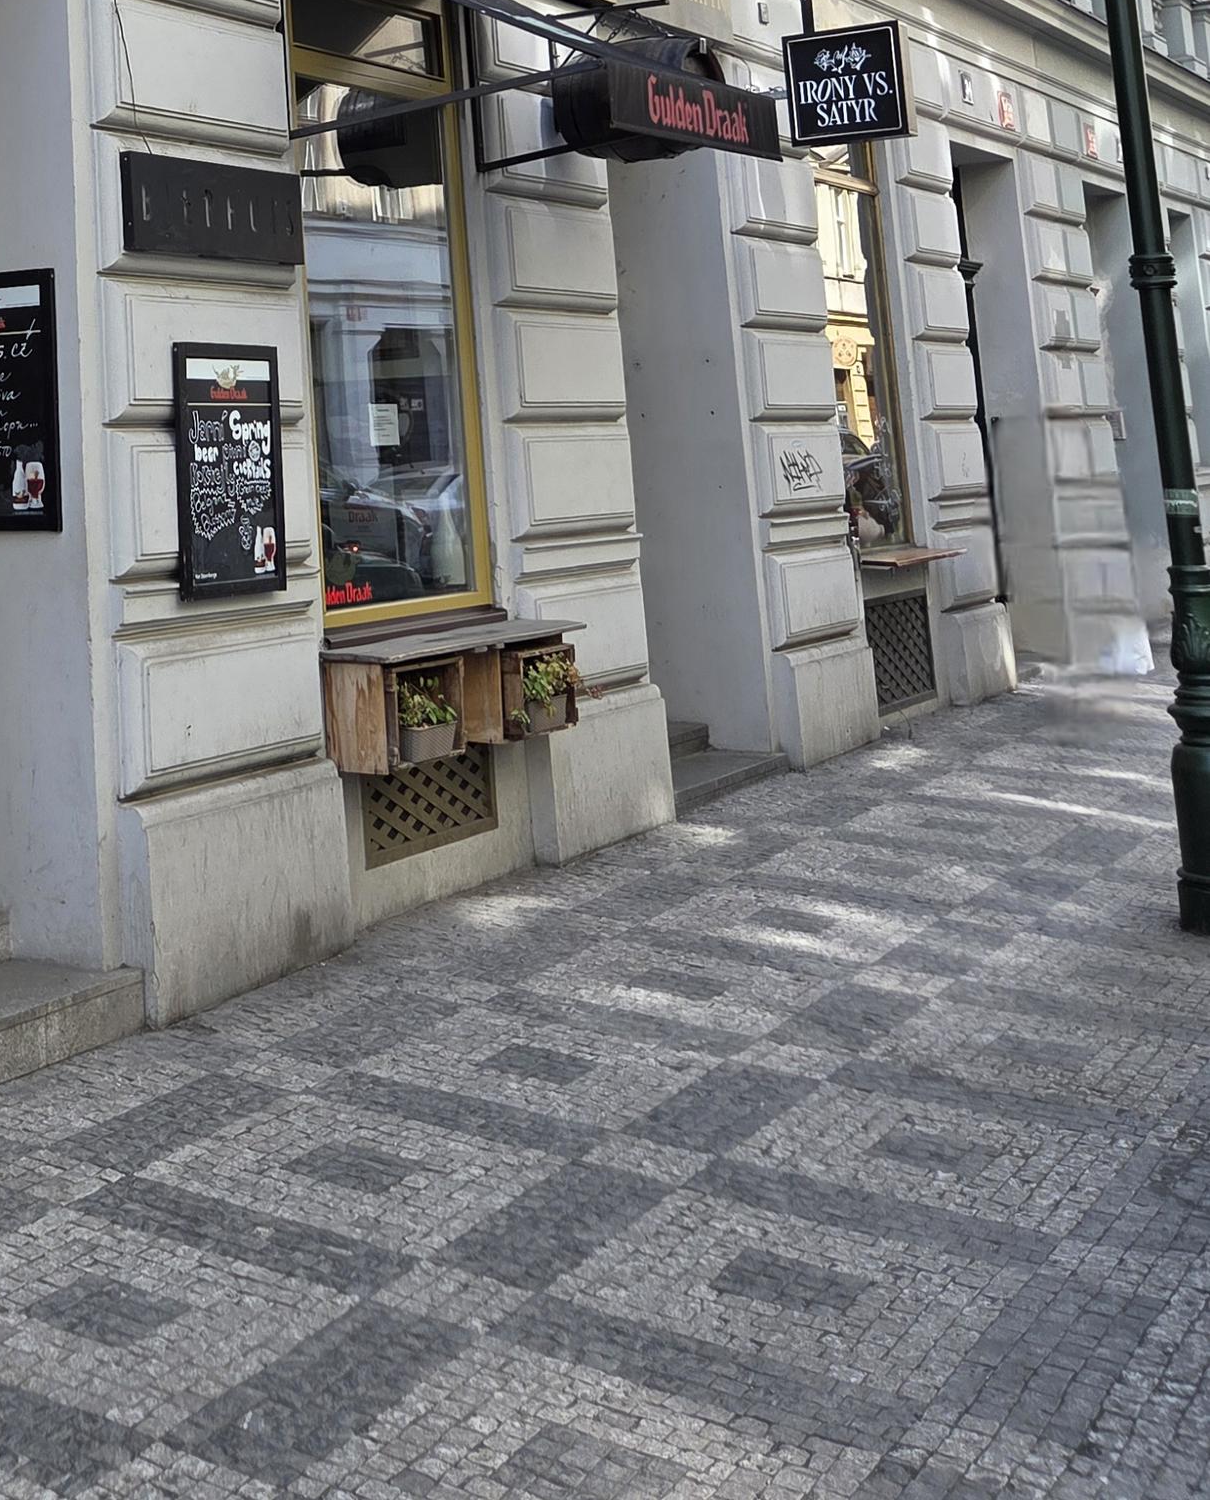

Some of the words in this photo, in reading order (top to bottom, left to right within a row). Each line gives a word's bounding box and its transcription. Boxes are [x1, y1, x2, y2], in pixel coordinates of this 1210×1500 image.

[798, 75, 857, 104] IRONY
[862, 71, 893, 96] VS.
[648, 74, 703, 133] Gulden
[702, 90, 749, 143] Draak
[816, 98, 878, 127] SATYR
[229, 410, 270, 455] Spring
[194, 444, 218, 462] beer
[345, 580, 373, 603] Draak
